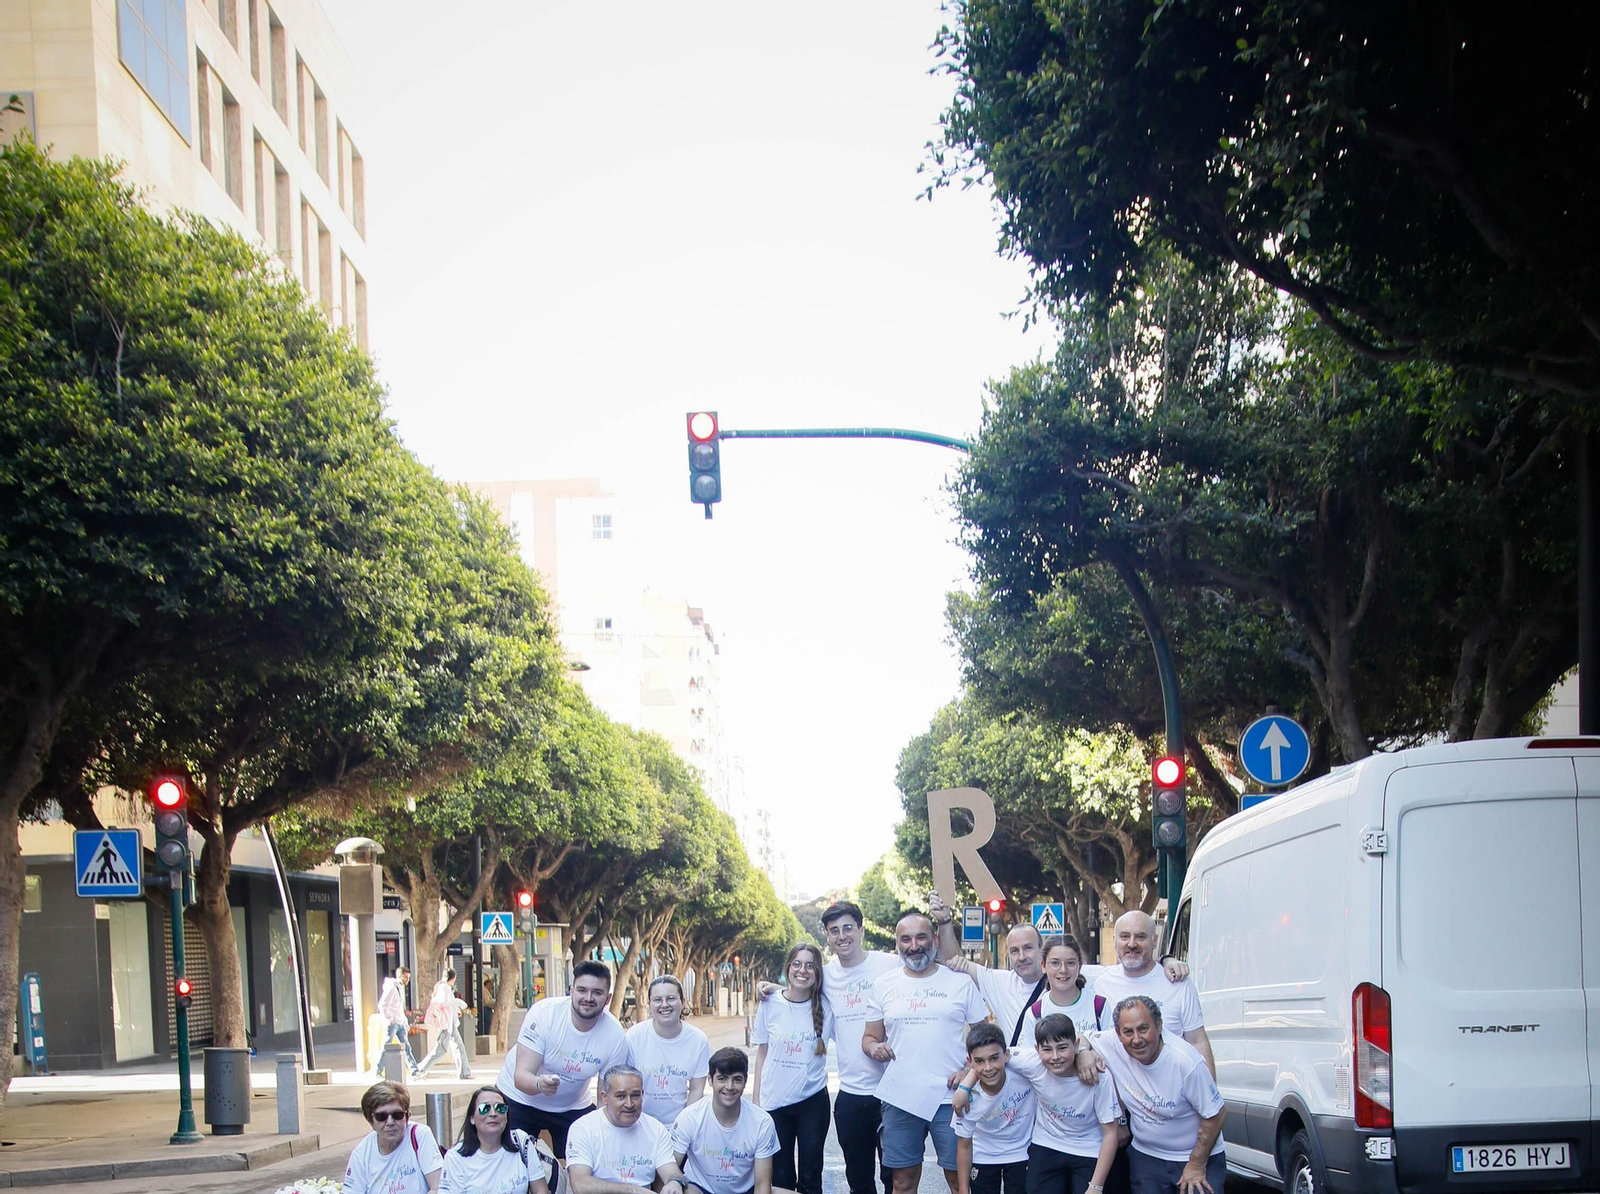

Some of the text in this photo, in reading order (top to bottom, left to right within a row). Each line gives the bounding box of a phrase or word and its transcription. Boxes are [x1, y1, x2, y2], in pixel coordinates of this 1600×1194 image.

[926, 786, 1006, 907] R
[1458, 1024, 1541, 1034] TRANSIT
[1468, 1148, 1517, 1168] 1826
[1527, 1146, 1566, 1167] HYJ
